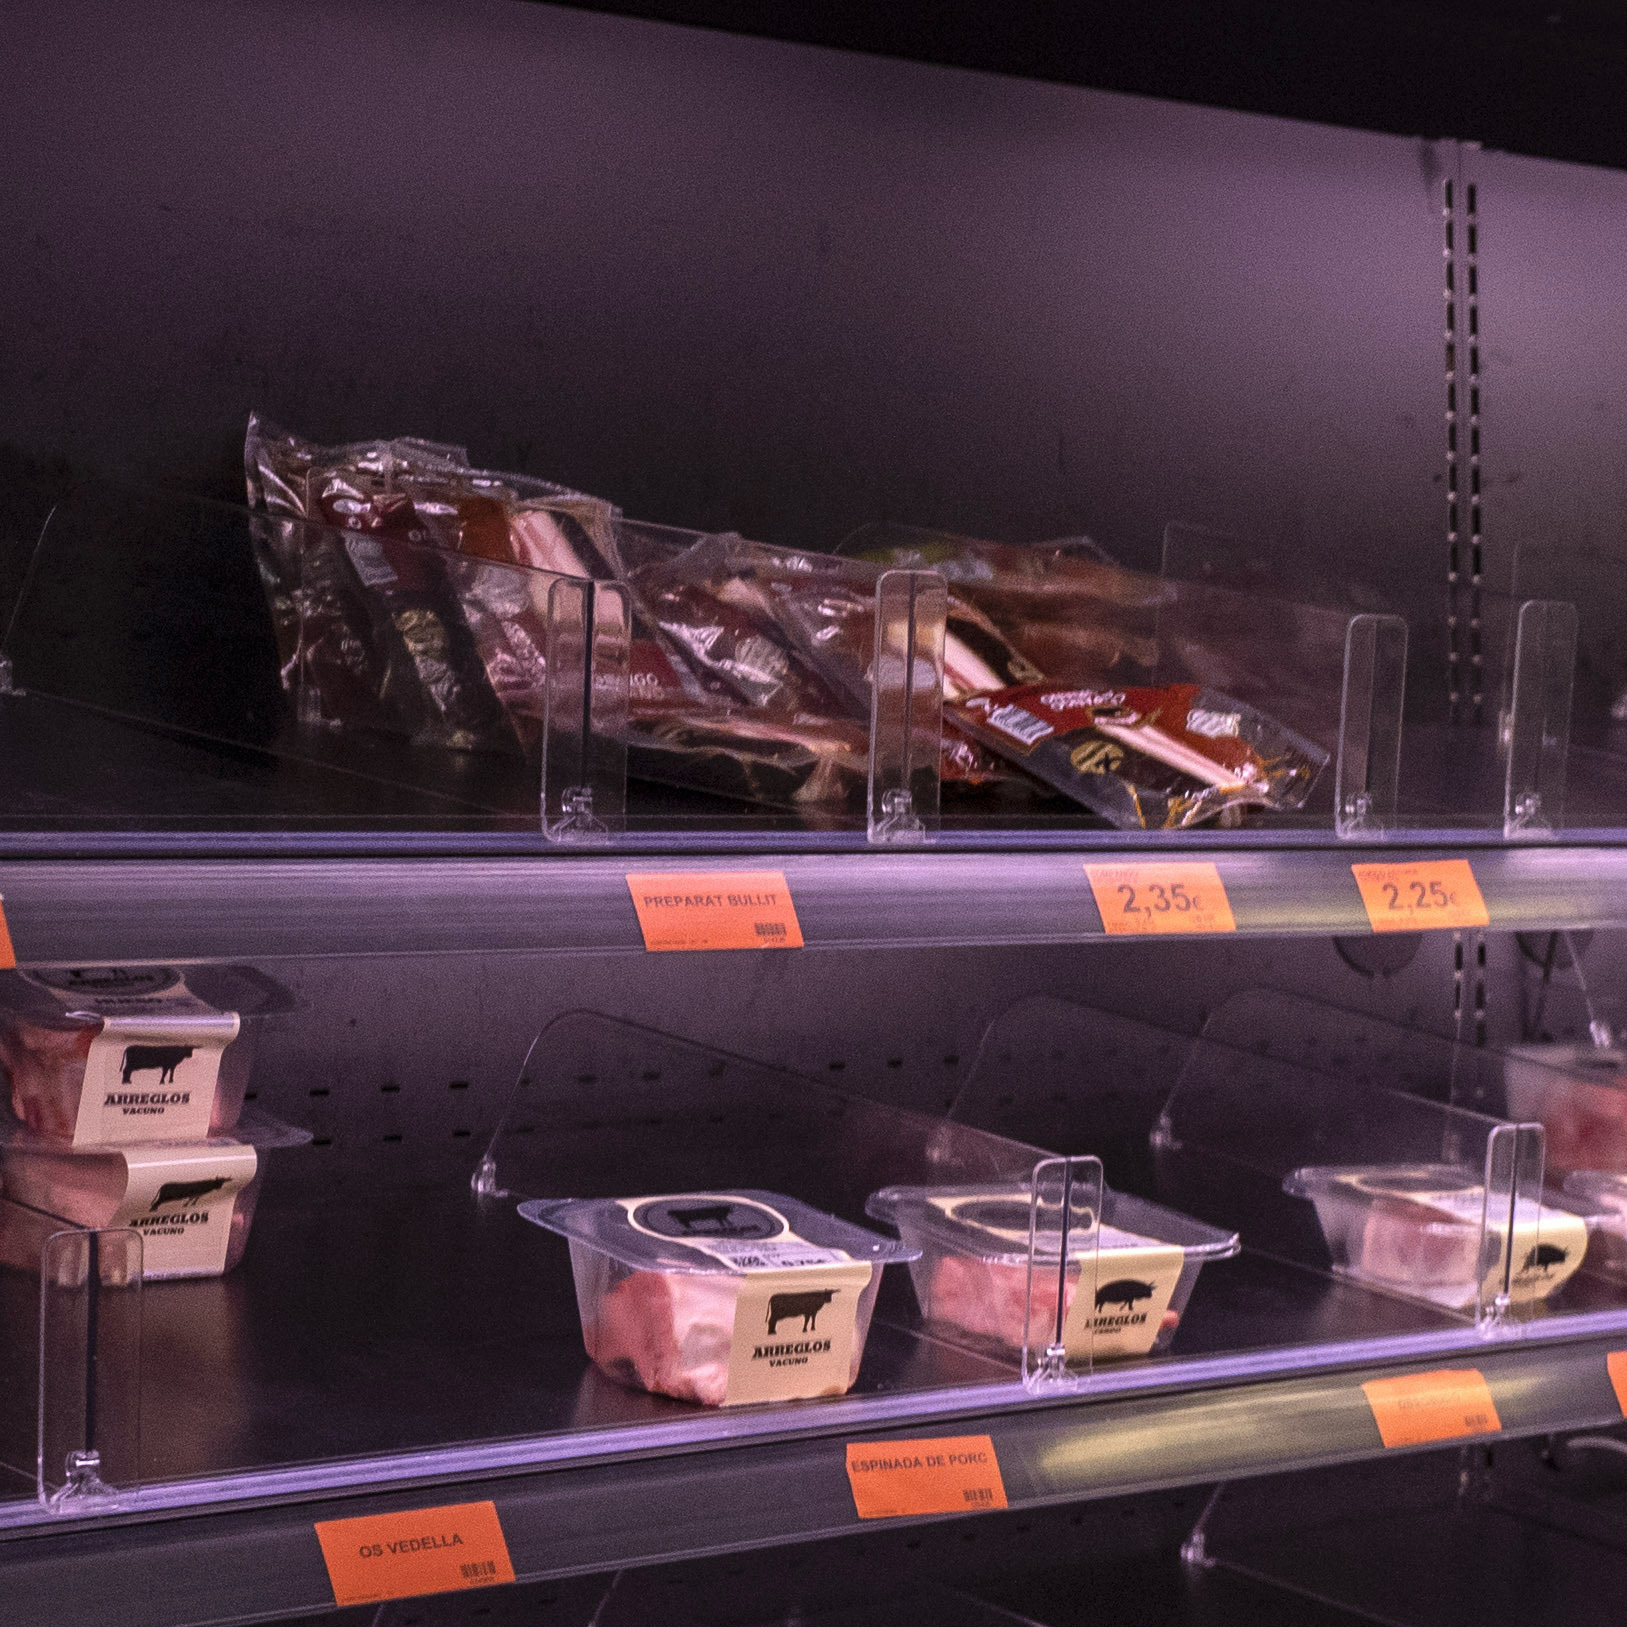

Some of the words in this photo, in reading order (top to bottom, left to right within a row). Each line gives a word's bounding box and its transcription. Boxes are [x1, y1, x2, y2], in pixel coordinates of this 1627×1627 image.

[643, 894, 723, 908] PREPARAT
[728, 894, 777, 907] BULLIT
[104, 1092, 190, 1107] ARREGLOS
[123, 1107, 165, 1115] VACUNO
[129, 1212, 209, 1227] ARREGLOS
[143, 1227, 185, 1236] VACUNO
[752, 1340, 831, 1360] ARREGLOS
[769, 1357, 809, 1367] VACUNO
[852, 1457, 923, 1473] ESPINADA
[926, 1455, 946, 1468] DE
[949, 1452, 988, 1465] PORC
[359, 1545, 383, 1559] OS
[387, 1533, 464, 1556] VEDELLA
